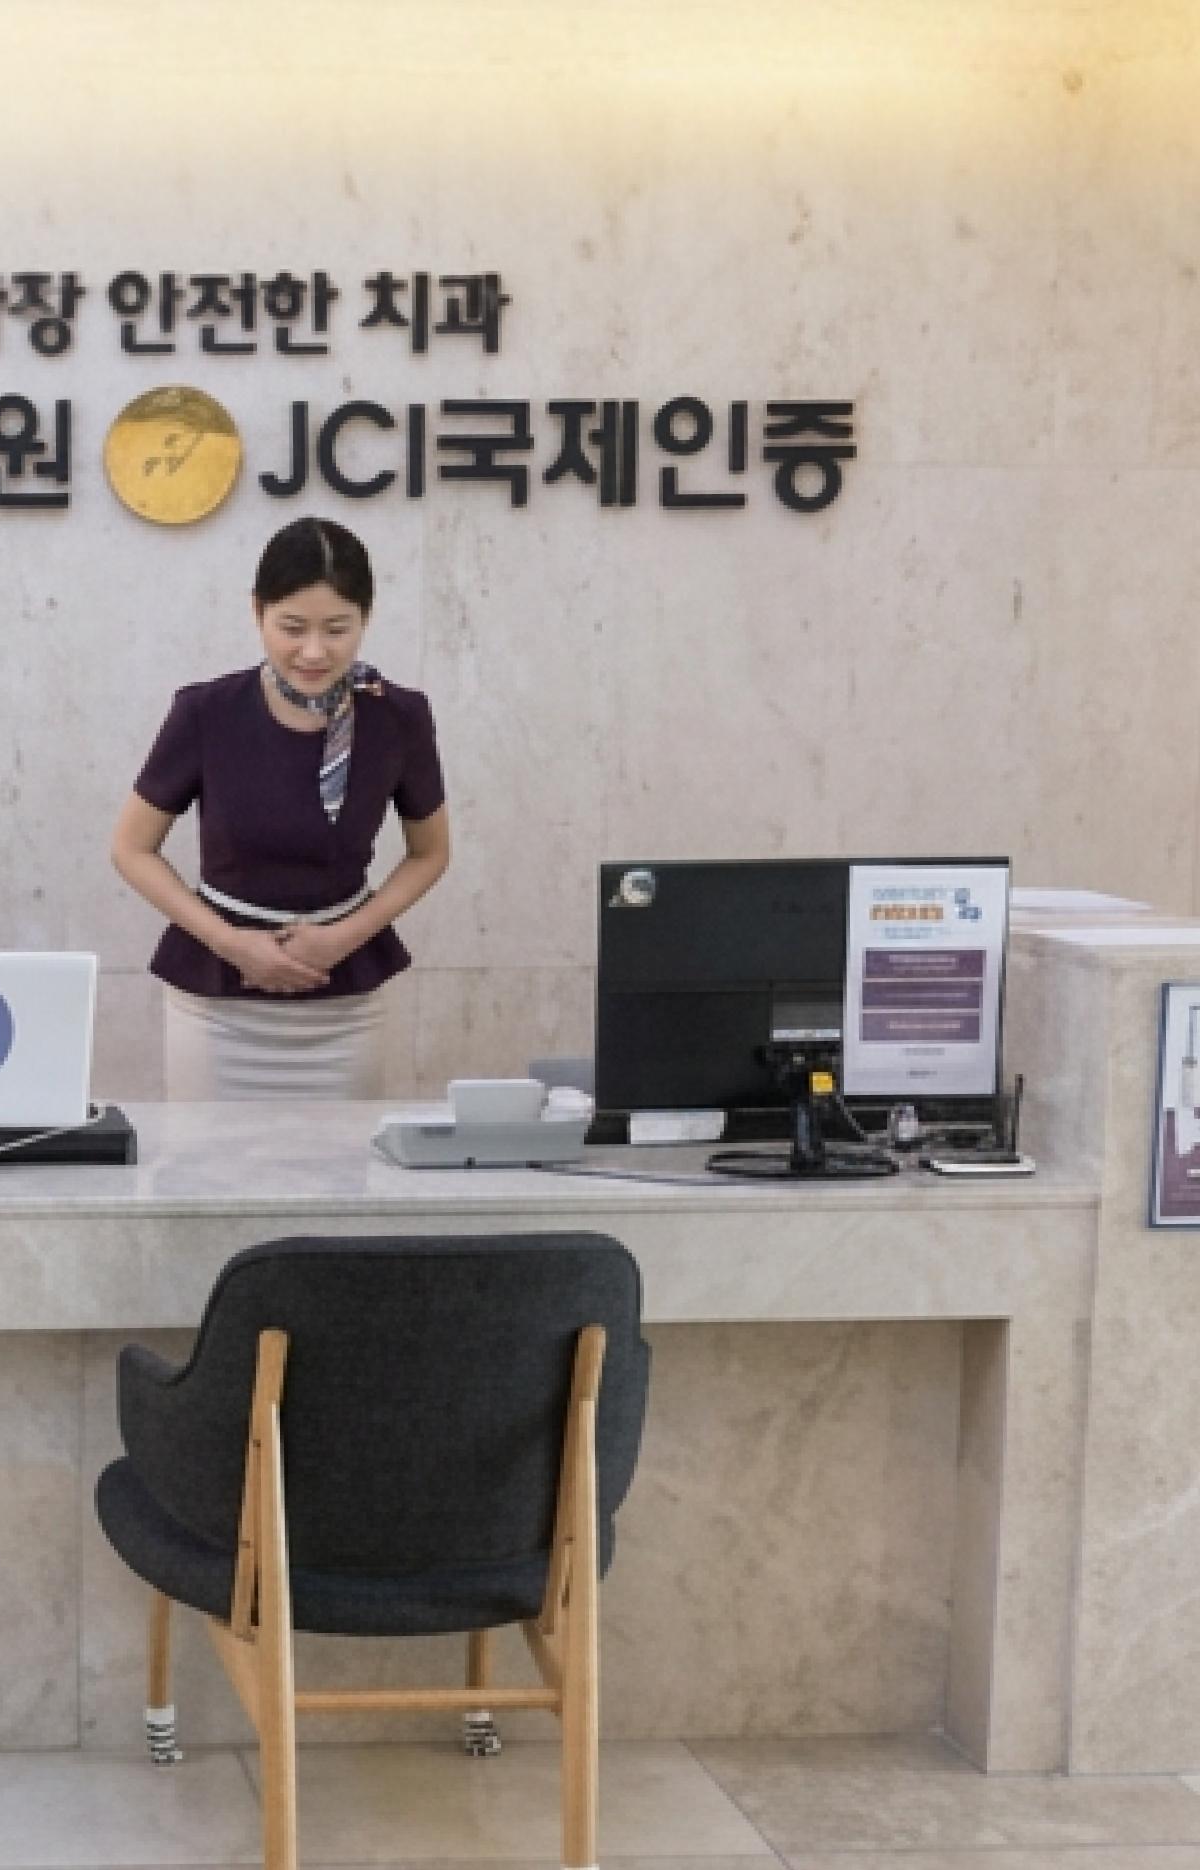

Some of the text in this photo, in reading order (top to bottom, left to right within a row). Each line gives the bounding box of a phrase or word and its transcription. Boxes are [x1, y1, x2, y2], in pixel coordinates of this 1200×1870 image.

[107, 270, 338, 356] 안전한
[360, 271, 510, 355] 치과
[257, 395, 860, 513] JCI국제인증
